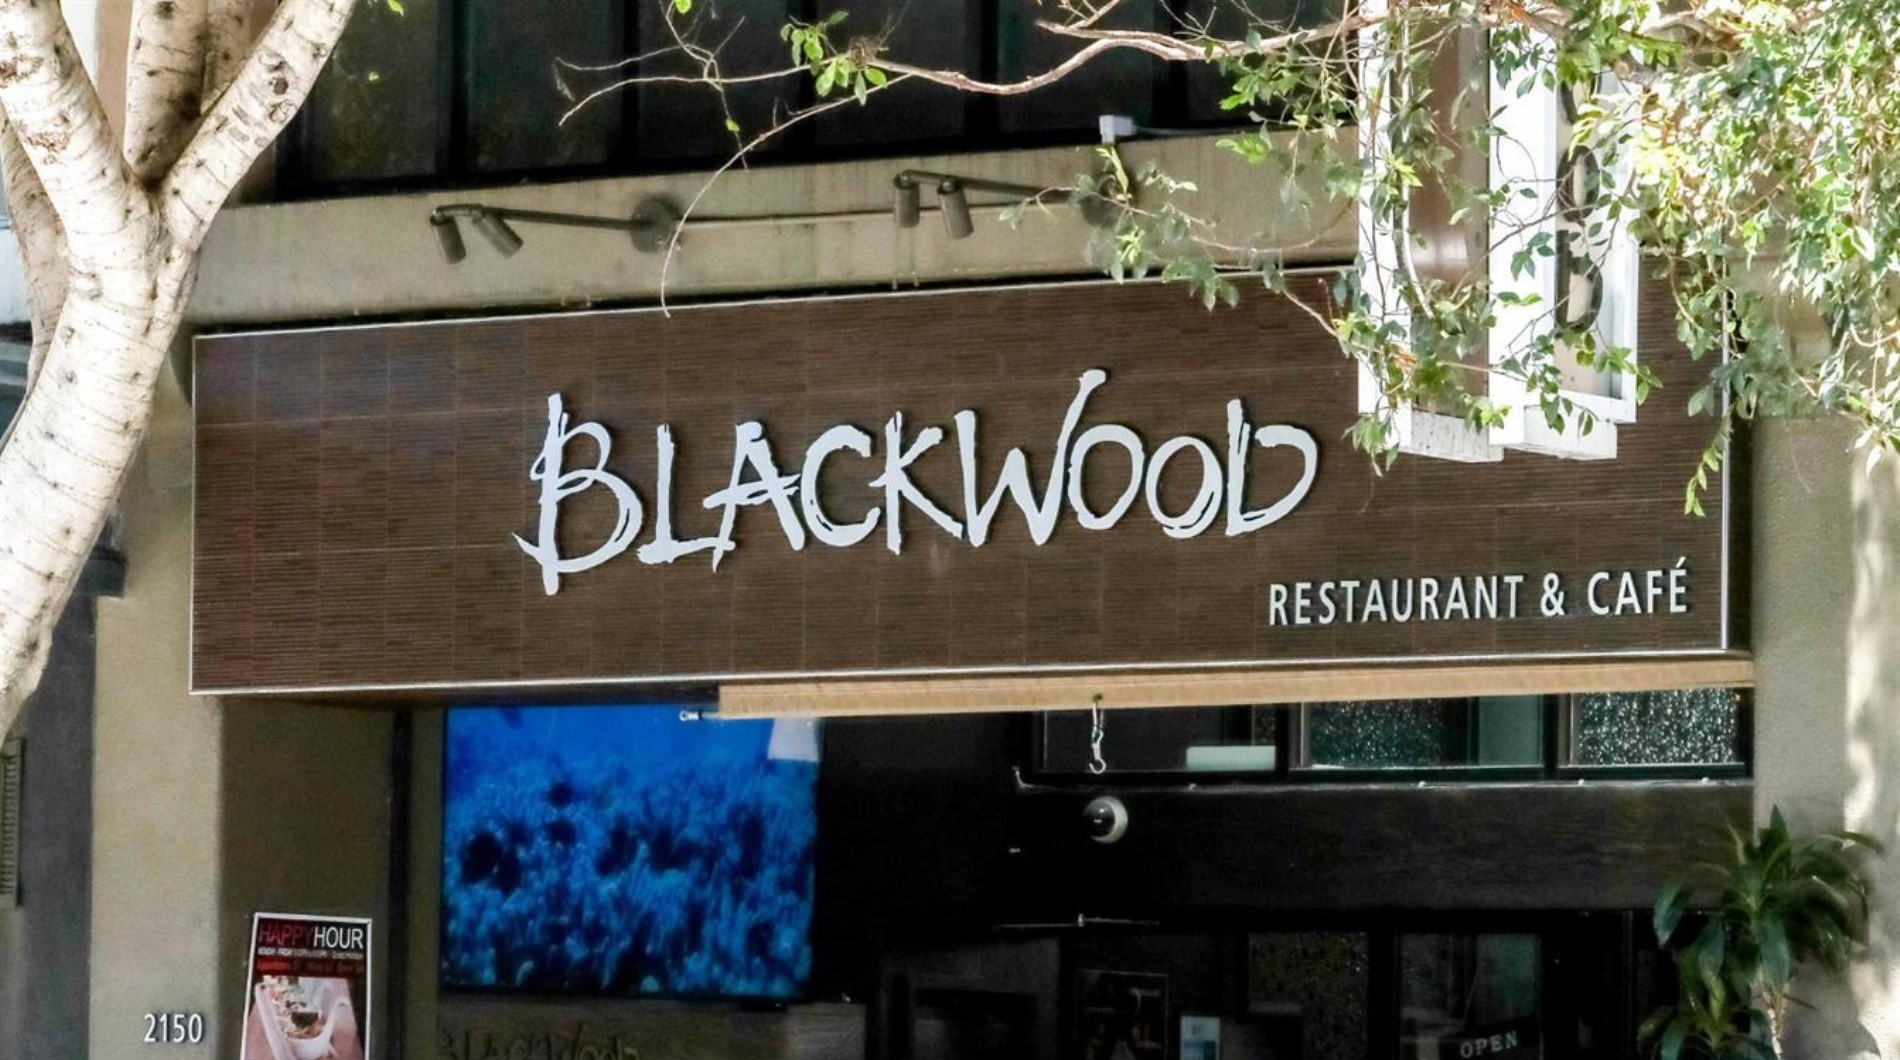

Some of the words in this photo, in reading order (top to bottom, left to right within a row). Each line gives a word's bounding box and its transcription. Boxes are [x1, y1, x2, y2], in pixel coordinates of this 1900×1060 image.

[512, 369, 1319, 596] BLACKWOOD
[1269, 574, 1525, 626] RESTAURANT
[1539, 572, 1566, 618] &
[1587, 556, 1688, 617] CAFÉ
[143, 1013, 204, 1043] 2150
[1459, 1029, 1518, 1060] OPEN
